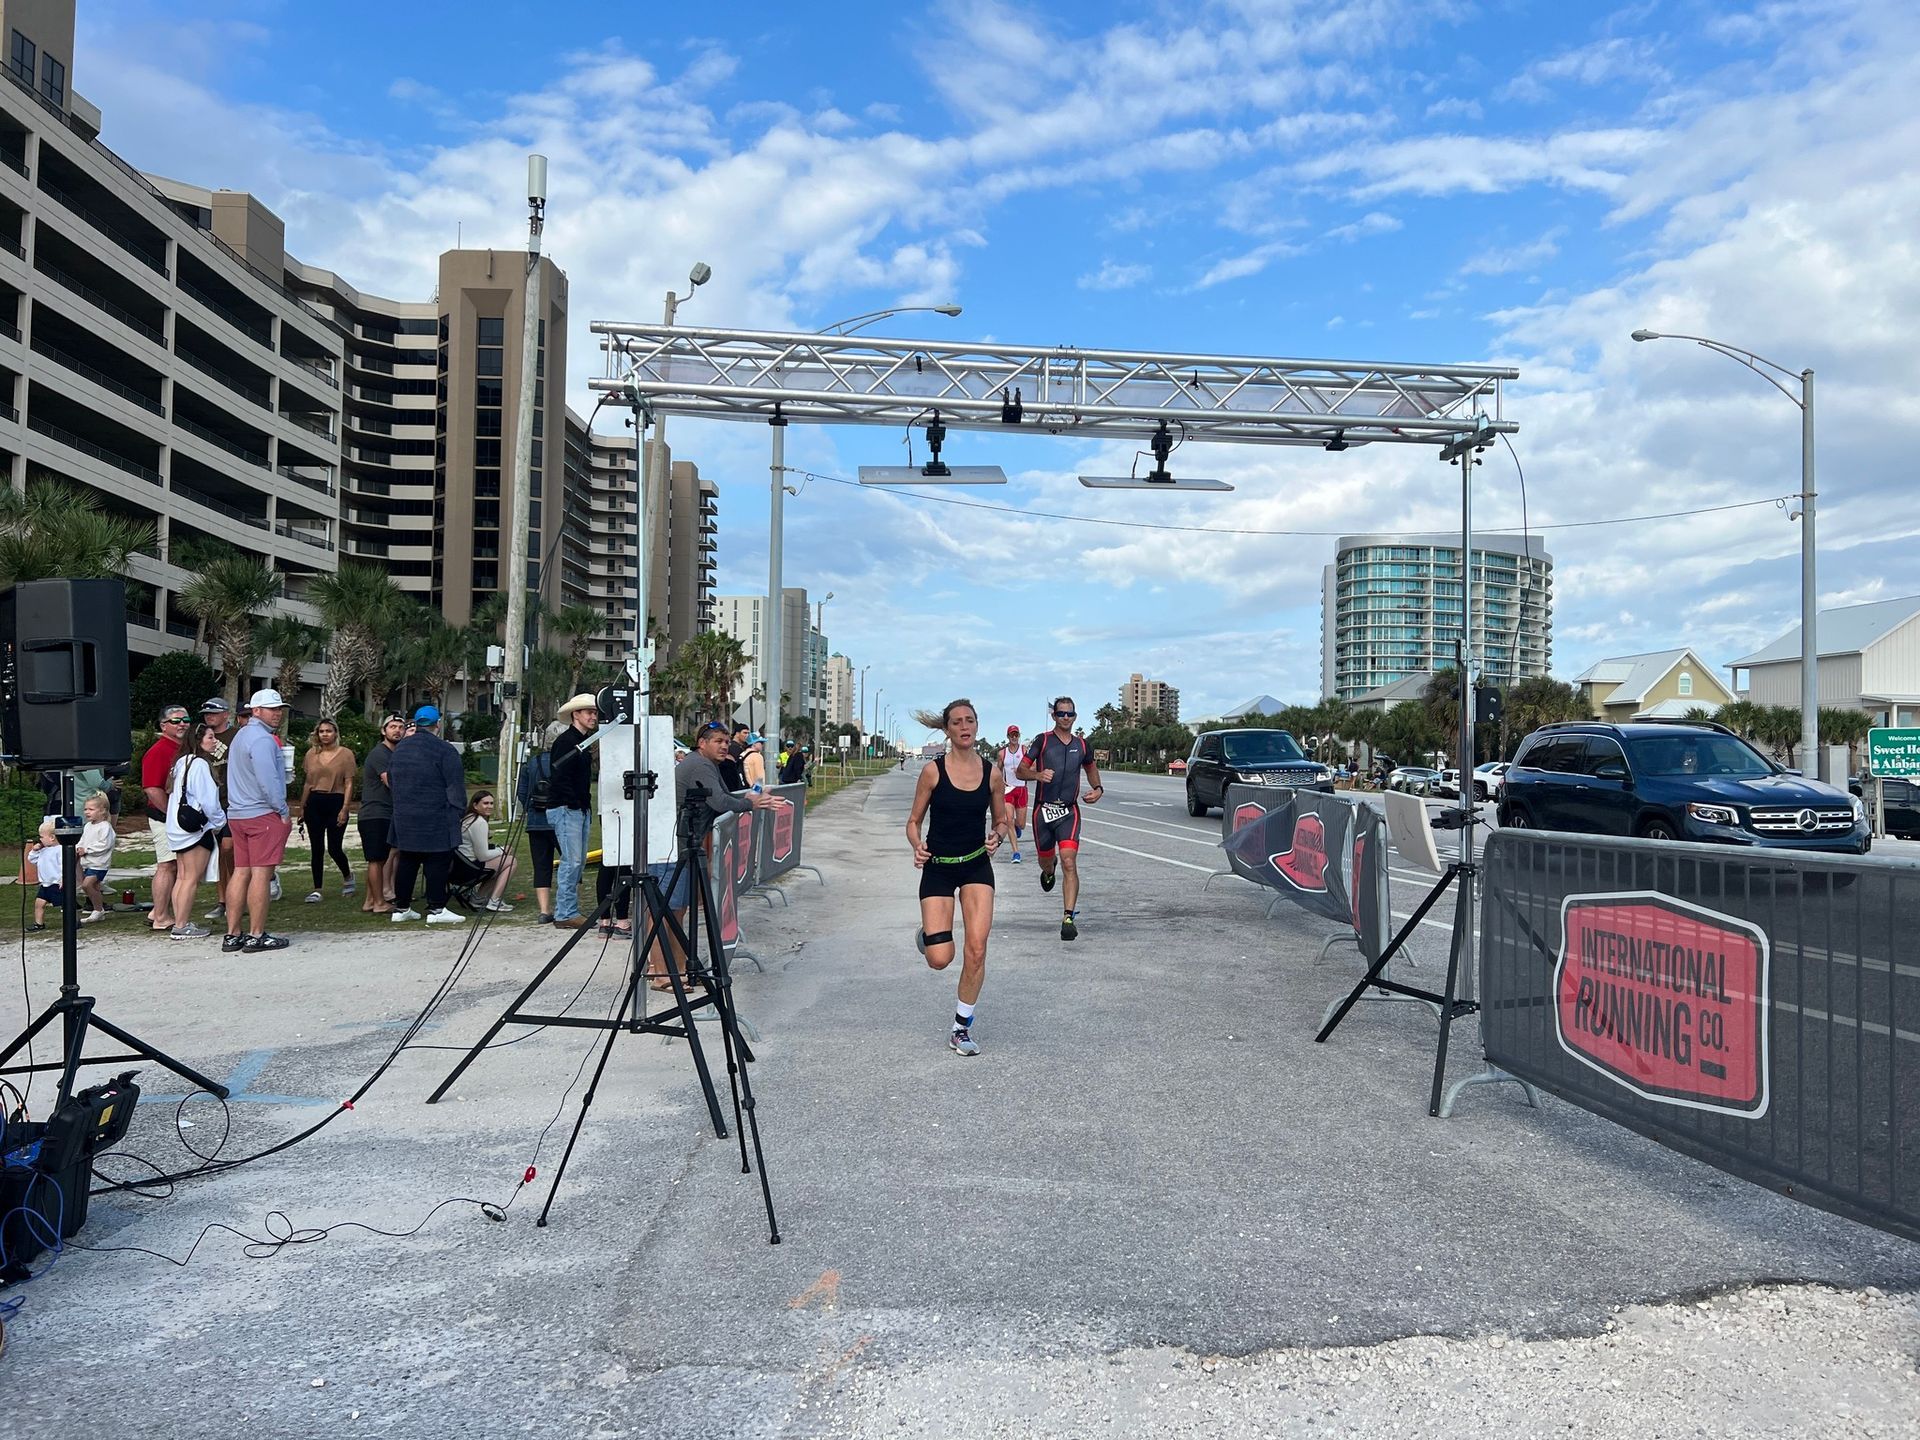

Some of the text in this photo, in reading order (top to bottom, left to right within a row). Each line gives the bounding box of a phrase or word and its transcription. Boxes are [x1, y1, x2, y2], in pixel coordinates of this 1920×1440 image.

[1873, 744, 1905, 755] Sweet
[1581, 926, 1732, 1005] INTERNATIONAL
[1574, 975, 1730, 1067] RUNNING CO.
